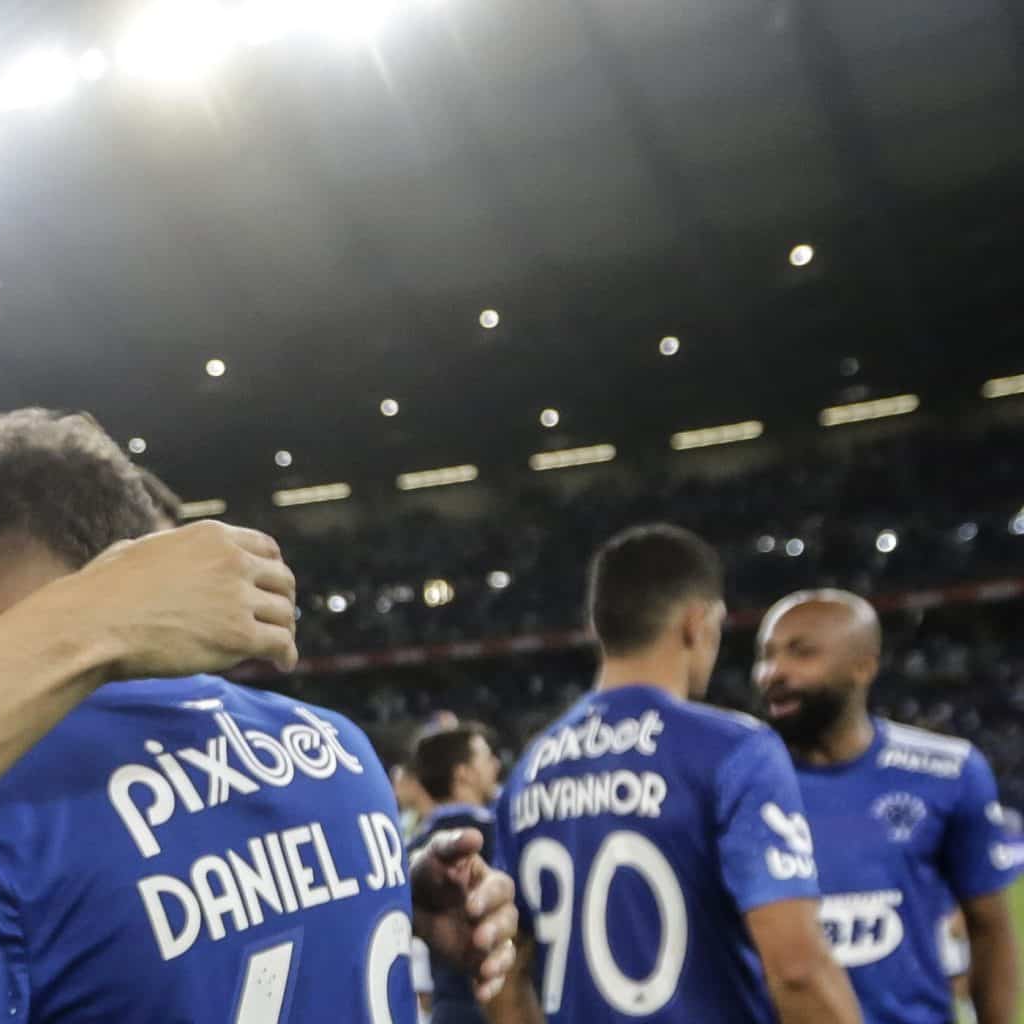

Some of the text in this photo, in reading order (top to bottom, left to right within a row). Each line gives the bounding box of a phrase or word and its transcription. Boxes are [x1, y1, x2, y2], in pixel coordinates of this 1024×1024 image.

[108, 699, 364, 858] pixbet
[136, 812, 406, 960] DANIEL JR
[519, 829, 688, 1017] 90
